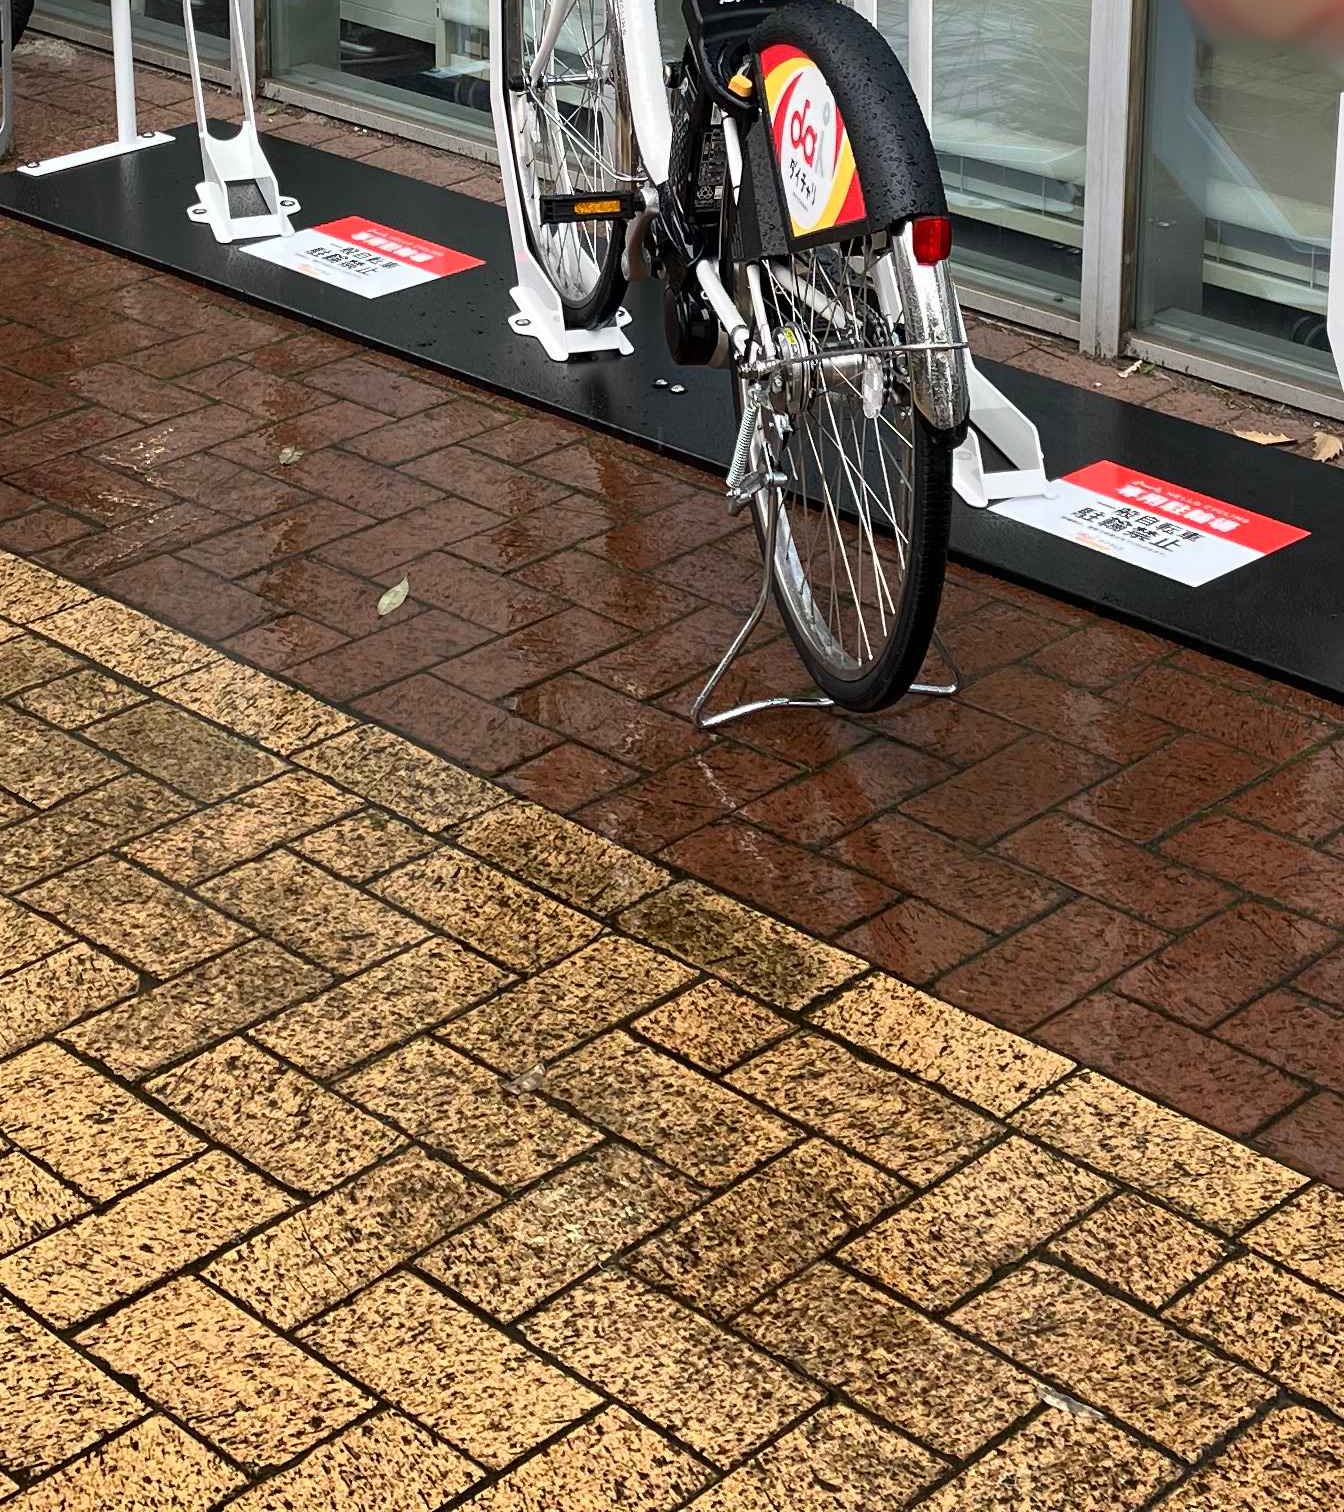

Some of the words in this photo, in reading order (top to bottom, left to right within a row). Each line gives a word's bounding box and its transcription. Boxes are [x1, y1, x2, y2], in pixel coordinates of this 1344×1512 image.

[789, 158, 817, 207] ダイチャリ
[1071, 506, 1184, 553] 駐輪禁止
[1096, 500, 1208, 542] 一般自転車
